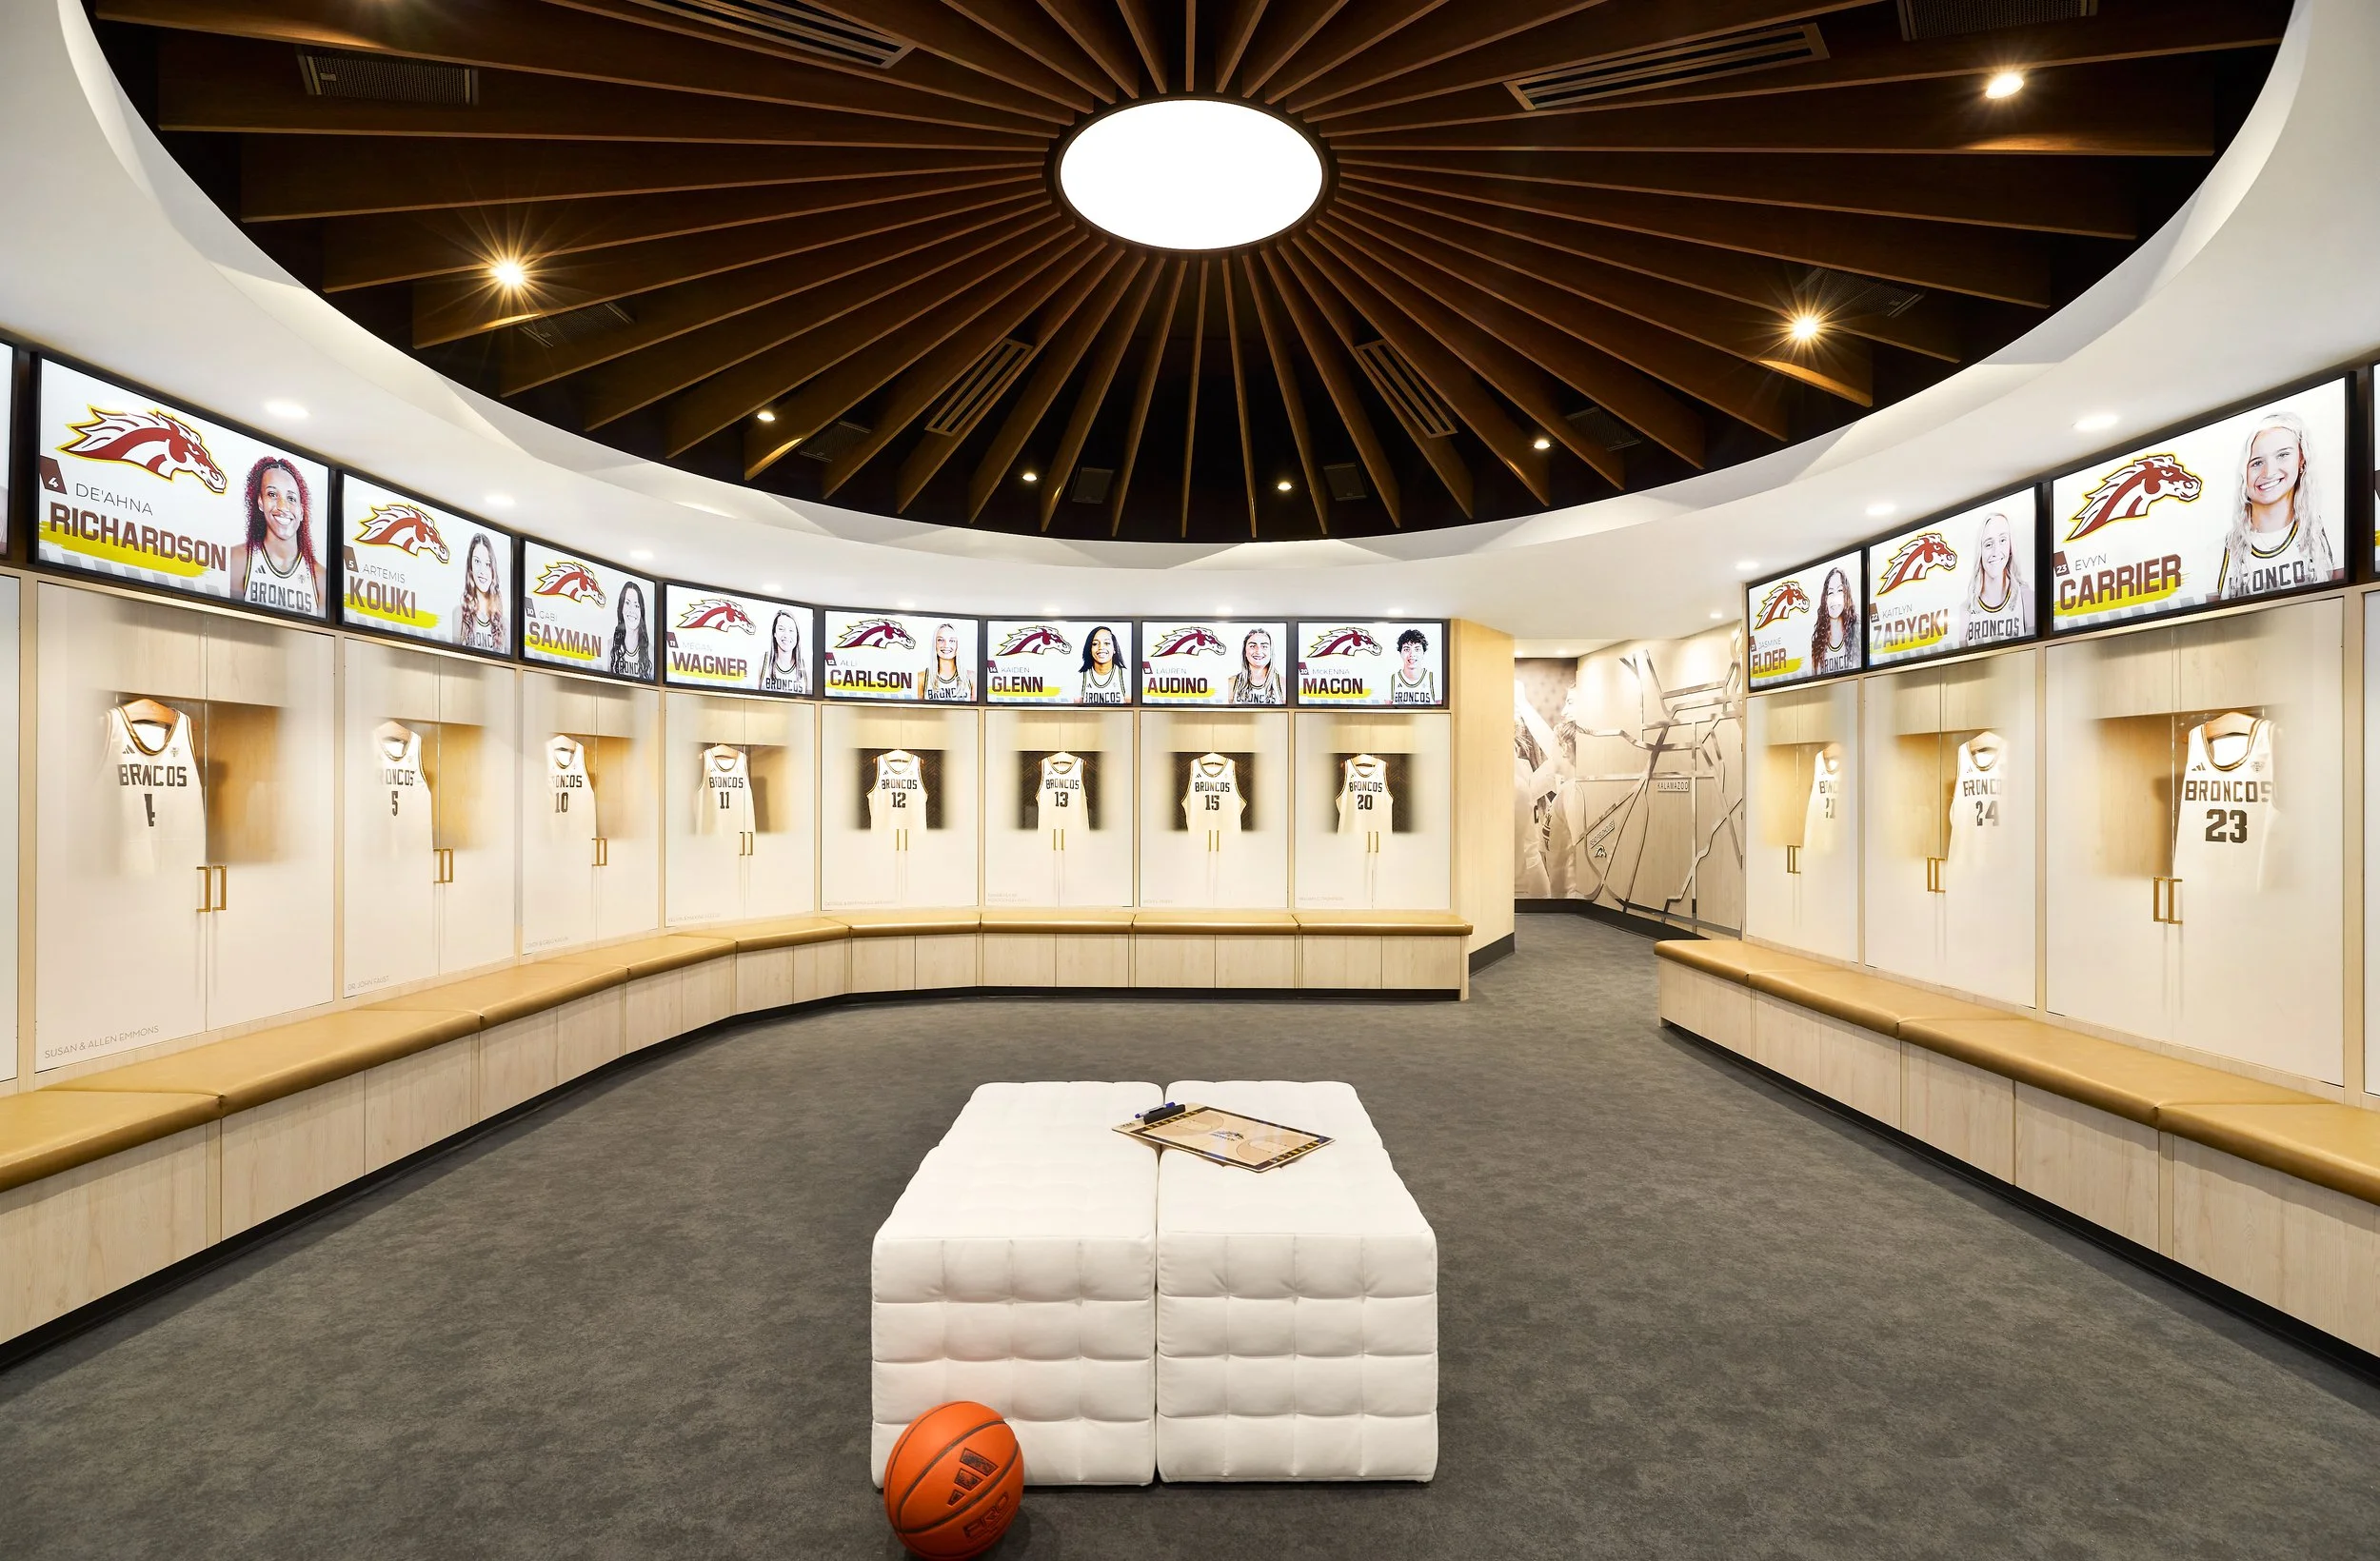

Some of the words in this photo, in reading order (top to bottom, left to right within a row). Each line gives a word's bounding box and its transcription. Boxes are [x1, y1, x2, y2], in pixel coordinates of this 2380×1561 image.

[48, 476, 59, 489] 4
[76, 483, 153, 516] DE'AHNA
[50, 501, 227, 571] RICHARDSON
[347, 560, 354, 568] 5
[2056, 563, 2068, 574] 23
[2075, 554, 2107, 571] EVYN
[363, 563, 406, 583] ARTEMIS
[2060, 554, 2182, 610] CARRIER
[250, 582, 311, 612] BRONCOS
[349, 576, 416, 619] KOUKI
[1882, 603, 1913, 619] KAITLYN
[1874, 608, 1949, 650] ZARYCKI
[1968, 618, 2019, 641] BRONCOS
[529, 622, 602, 658] SAXMAN
[672, 651, 747, 678] WAGNER
[1753, 647, 1787, 675] ELDER
[765, 678, 803, 693] BRONCOS
[830, 669, 912, 689] CARLSON
[992, 676, 1043, 693] GLENN
[1147, 677, 1208, 694] AUDINO
[1302, 678, 1363, 694] MACON
[1085, 692, 1121, 703] BRONCOS
[1395, 691, 1431, 702] BRONCOS
[882, 779, 918, 790] BRONCOS
[1045, 779, 1080, 790] BRONCOS
[1195, 781, 1230, 792] BRONCOS
[1349, 781, 1382, 792] BRONCOS
[1657, 781, 1689, 790] KALAMAZOO
[2185, 780, 2272, 802] BRONCOS
[391, 791, 399, 816] 5
[555, 792, 568, 813] 10
[720, 791, 729, 809] 11
[891, 792, 906, 808] 12
[1055, 792, 1069, 807] 13
[1205, 795, 1220, 811] 15
[1358, 794, 1373, 810] 20
[1975, 800, 2000, 827] 24
[2205, 809, 2248, 843] 23
[45, 1043, 78, 1058] SUSAN
[79, 1042, 87, 1051] &
[88, 1035, 117, 1049] ALLEN
[119, 1025, 159, 1041] EMMONS
